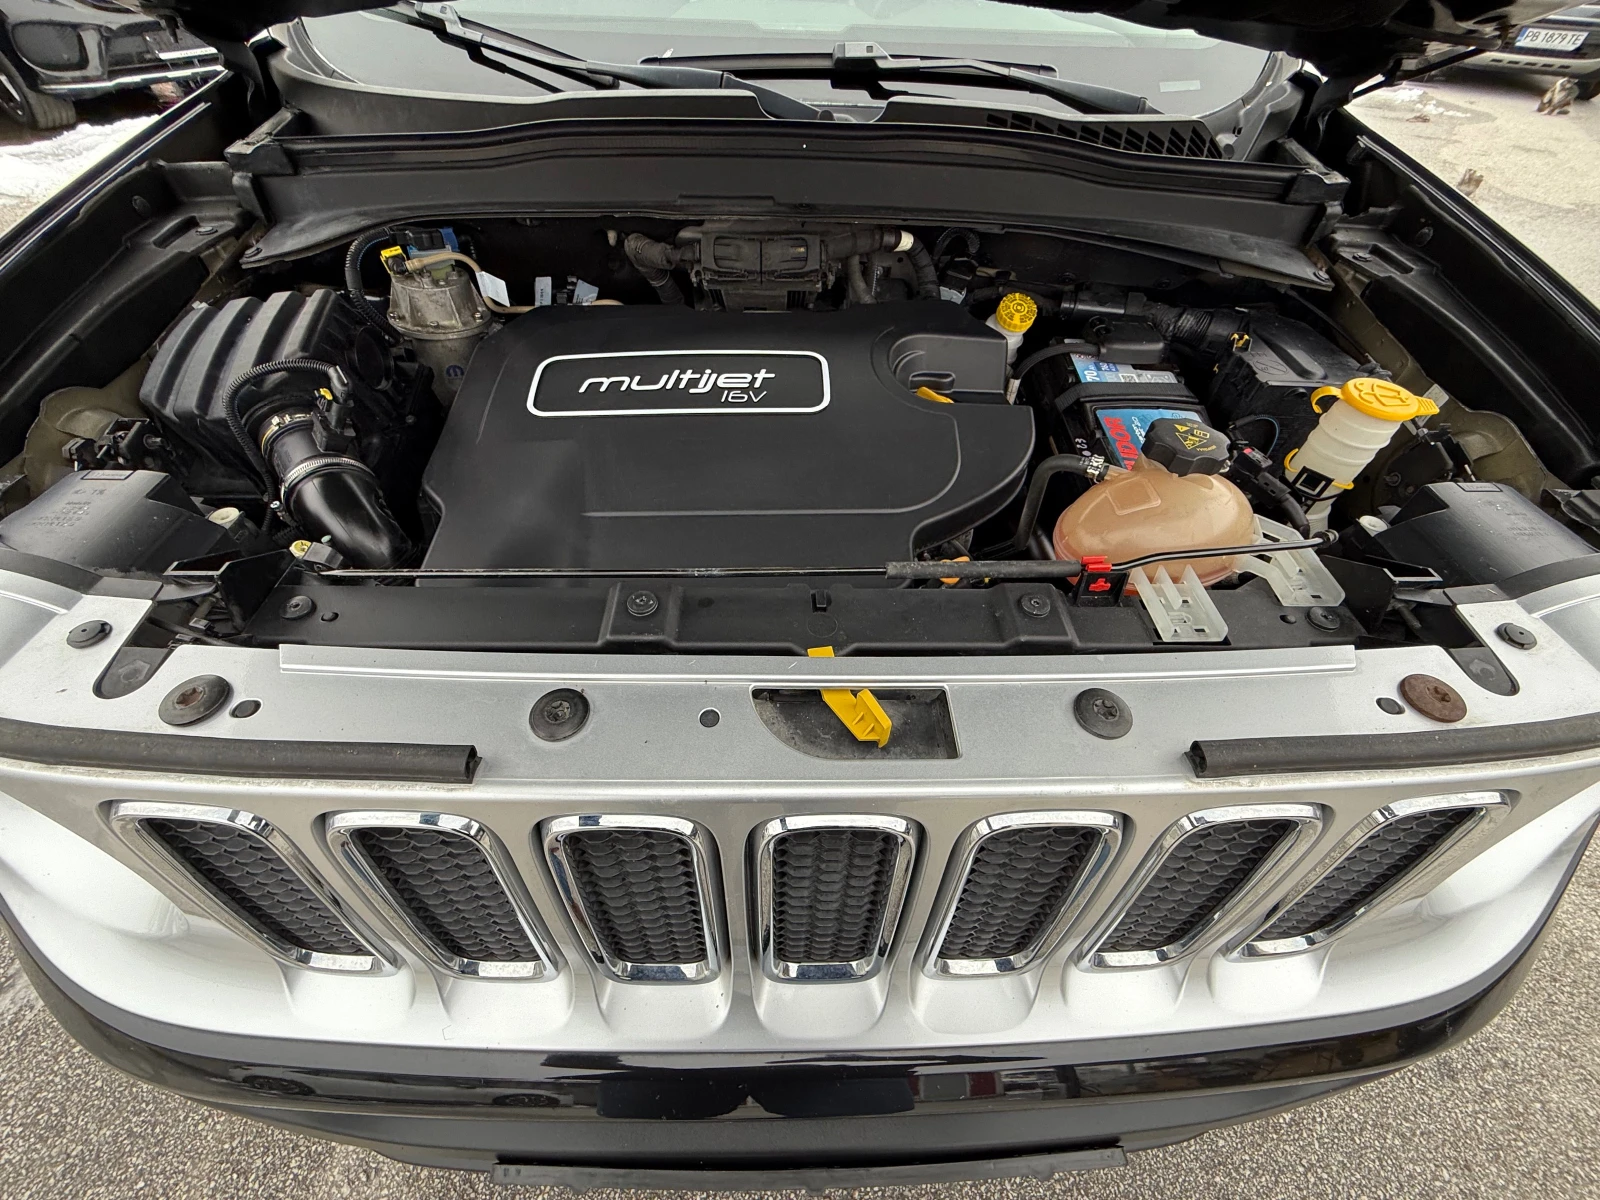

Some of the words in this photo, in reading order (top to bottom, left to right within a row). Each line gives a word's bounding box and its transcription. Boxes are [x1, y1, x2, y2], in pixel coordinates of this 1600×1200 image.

[1524, 30, 1541, 42] PB
[1541, 31, 1569, 45] 1879
[1567, 33, 1585, 46] TE
[578, 368, 776, 394] multijet
[1083, 370, 1101, 382] 70
[720, 390, 767, 403] 16V
